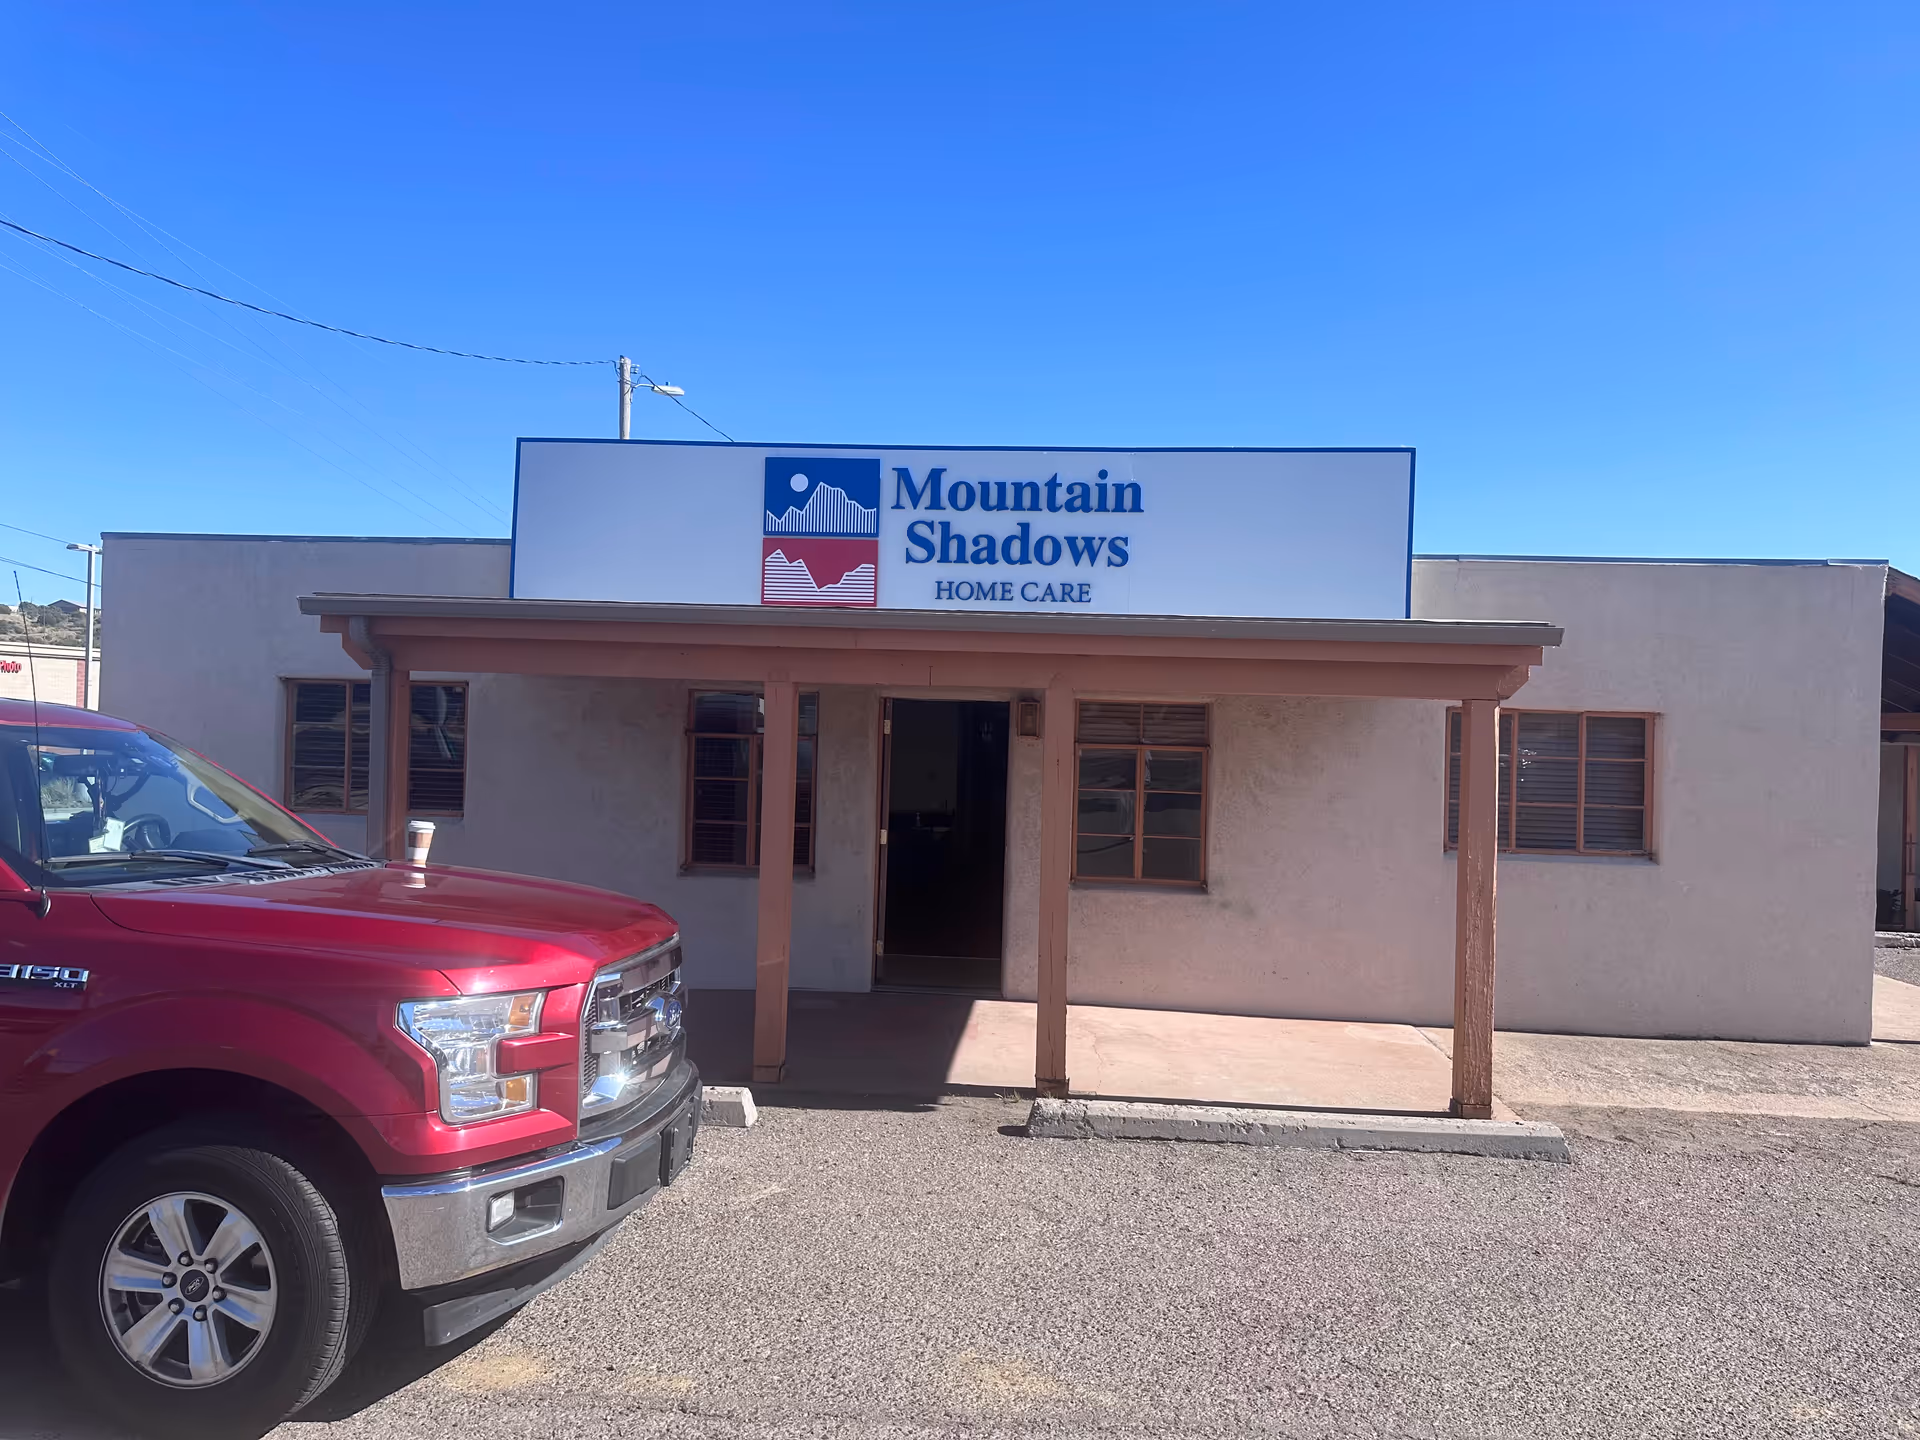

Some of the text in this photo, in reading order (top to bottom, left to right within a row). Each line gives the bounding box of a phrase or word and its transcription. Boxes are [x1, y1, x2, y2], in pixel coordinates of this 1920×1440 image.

[891, 467, 1144, 514] Mountain
[905, 520, 1130, 568] Shadows
[935, 580, 1092, 604] HOME CARE
[54, 981, 78, 989] XLT
